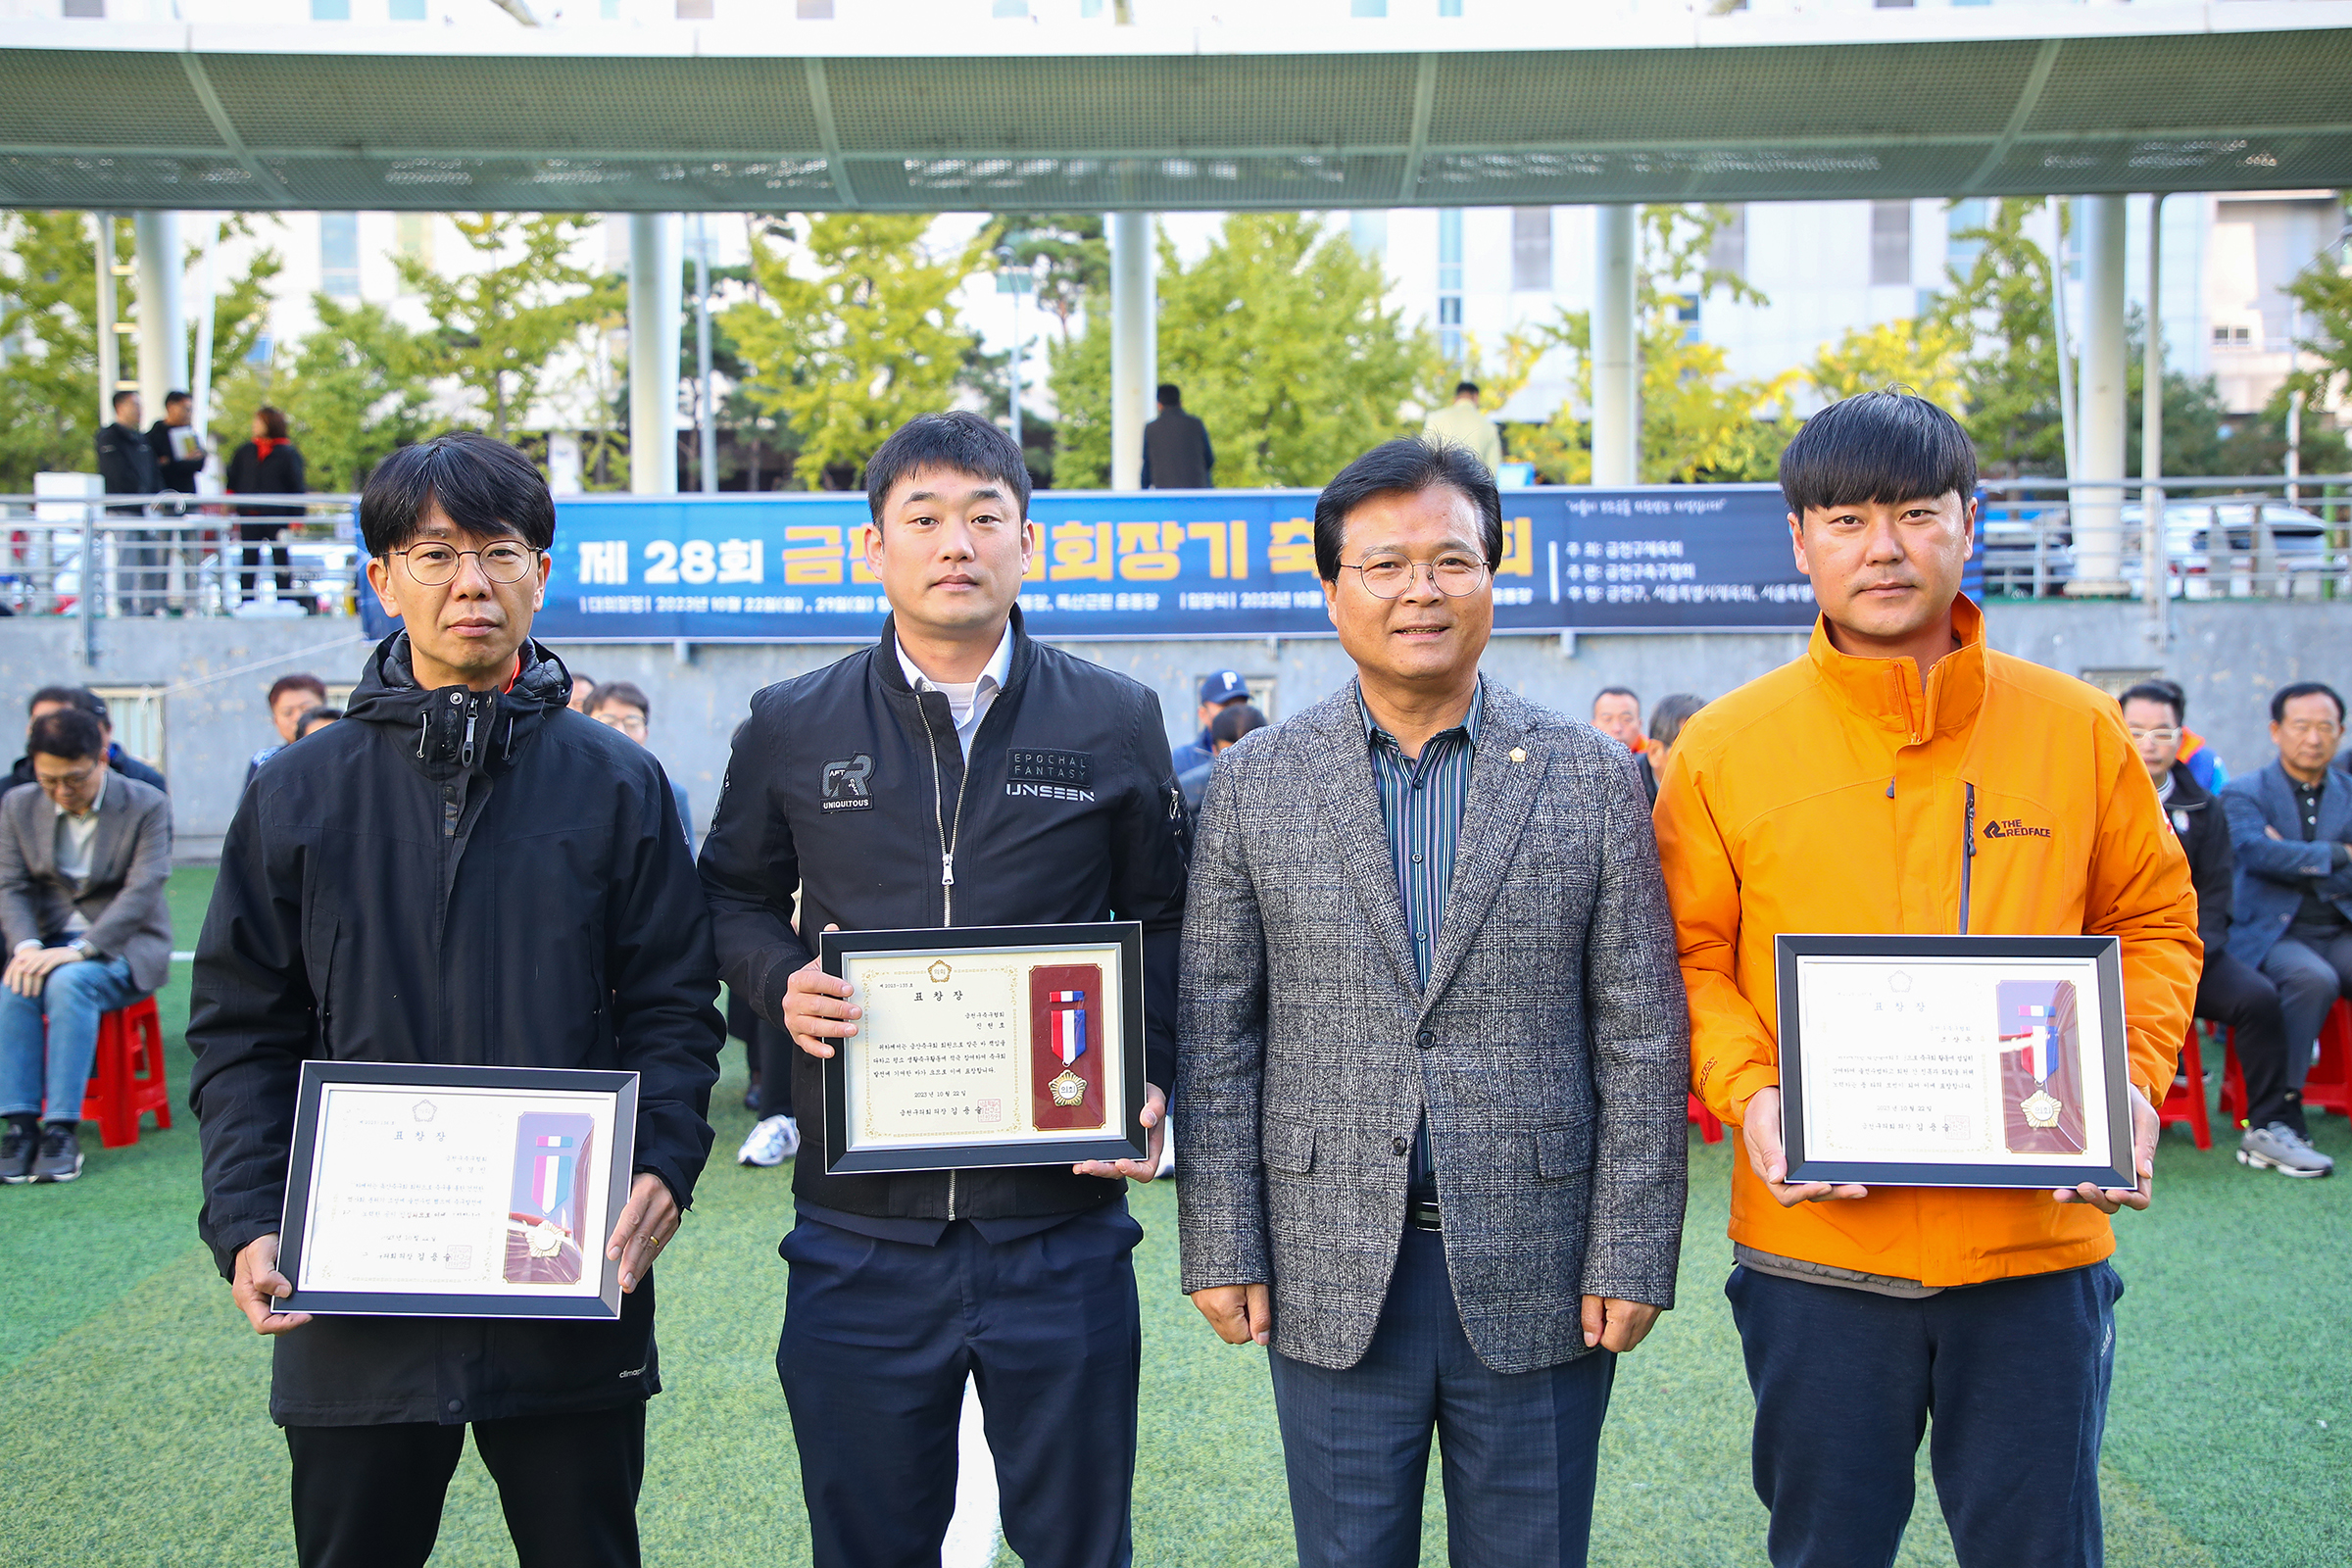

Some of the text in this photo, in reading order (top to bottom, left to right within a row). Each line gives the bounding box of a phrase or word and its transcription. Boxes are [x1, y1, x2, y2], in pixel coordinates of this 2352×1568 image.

[578, 539, 627, 585] 제
[643, 538, 763, 585] 28회
[655, 595, 710, 612] 2023년
[1240, 591, 1292, 610] 2023년
[1221, 671, 1238, 691] P
[1014, 753, 1087, 769] EPOCHAL
[1014, 764, 1086, 781] FANTASY
[1005, 783, 1096, 803] UNSEEN
[823, 799, 869, 809] UNIQUITOUS
[2000, 818, 2022, 828] THE
[2006, 827, 2051, 838] REDFACE
[913, 989, 963, 1002] 표 창 장
[1060, 1085, 1077, 1094] 의회
